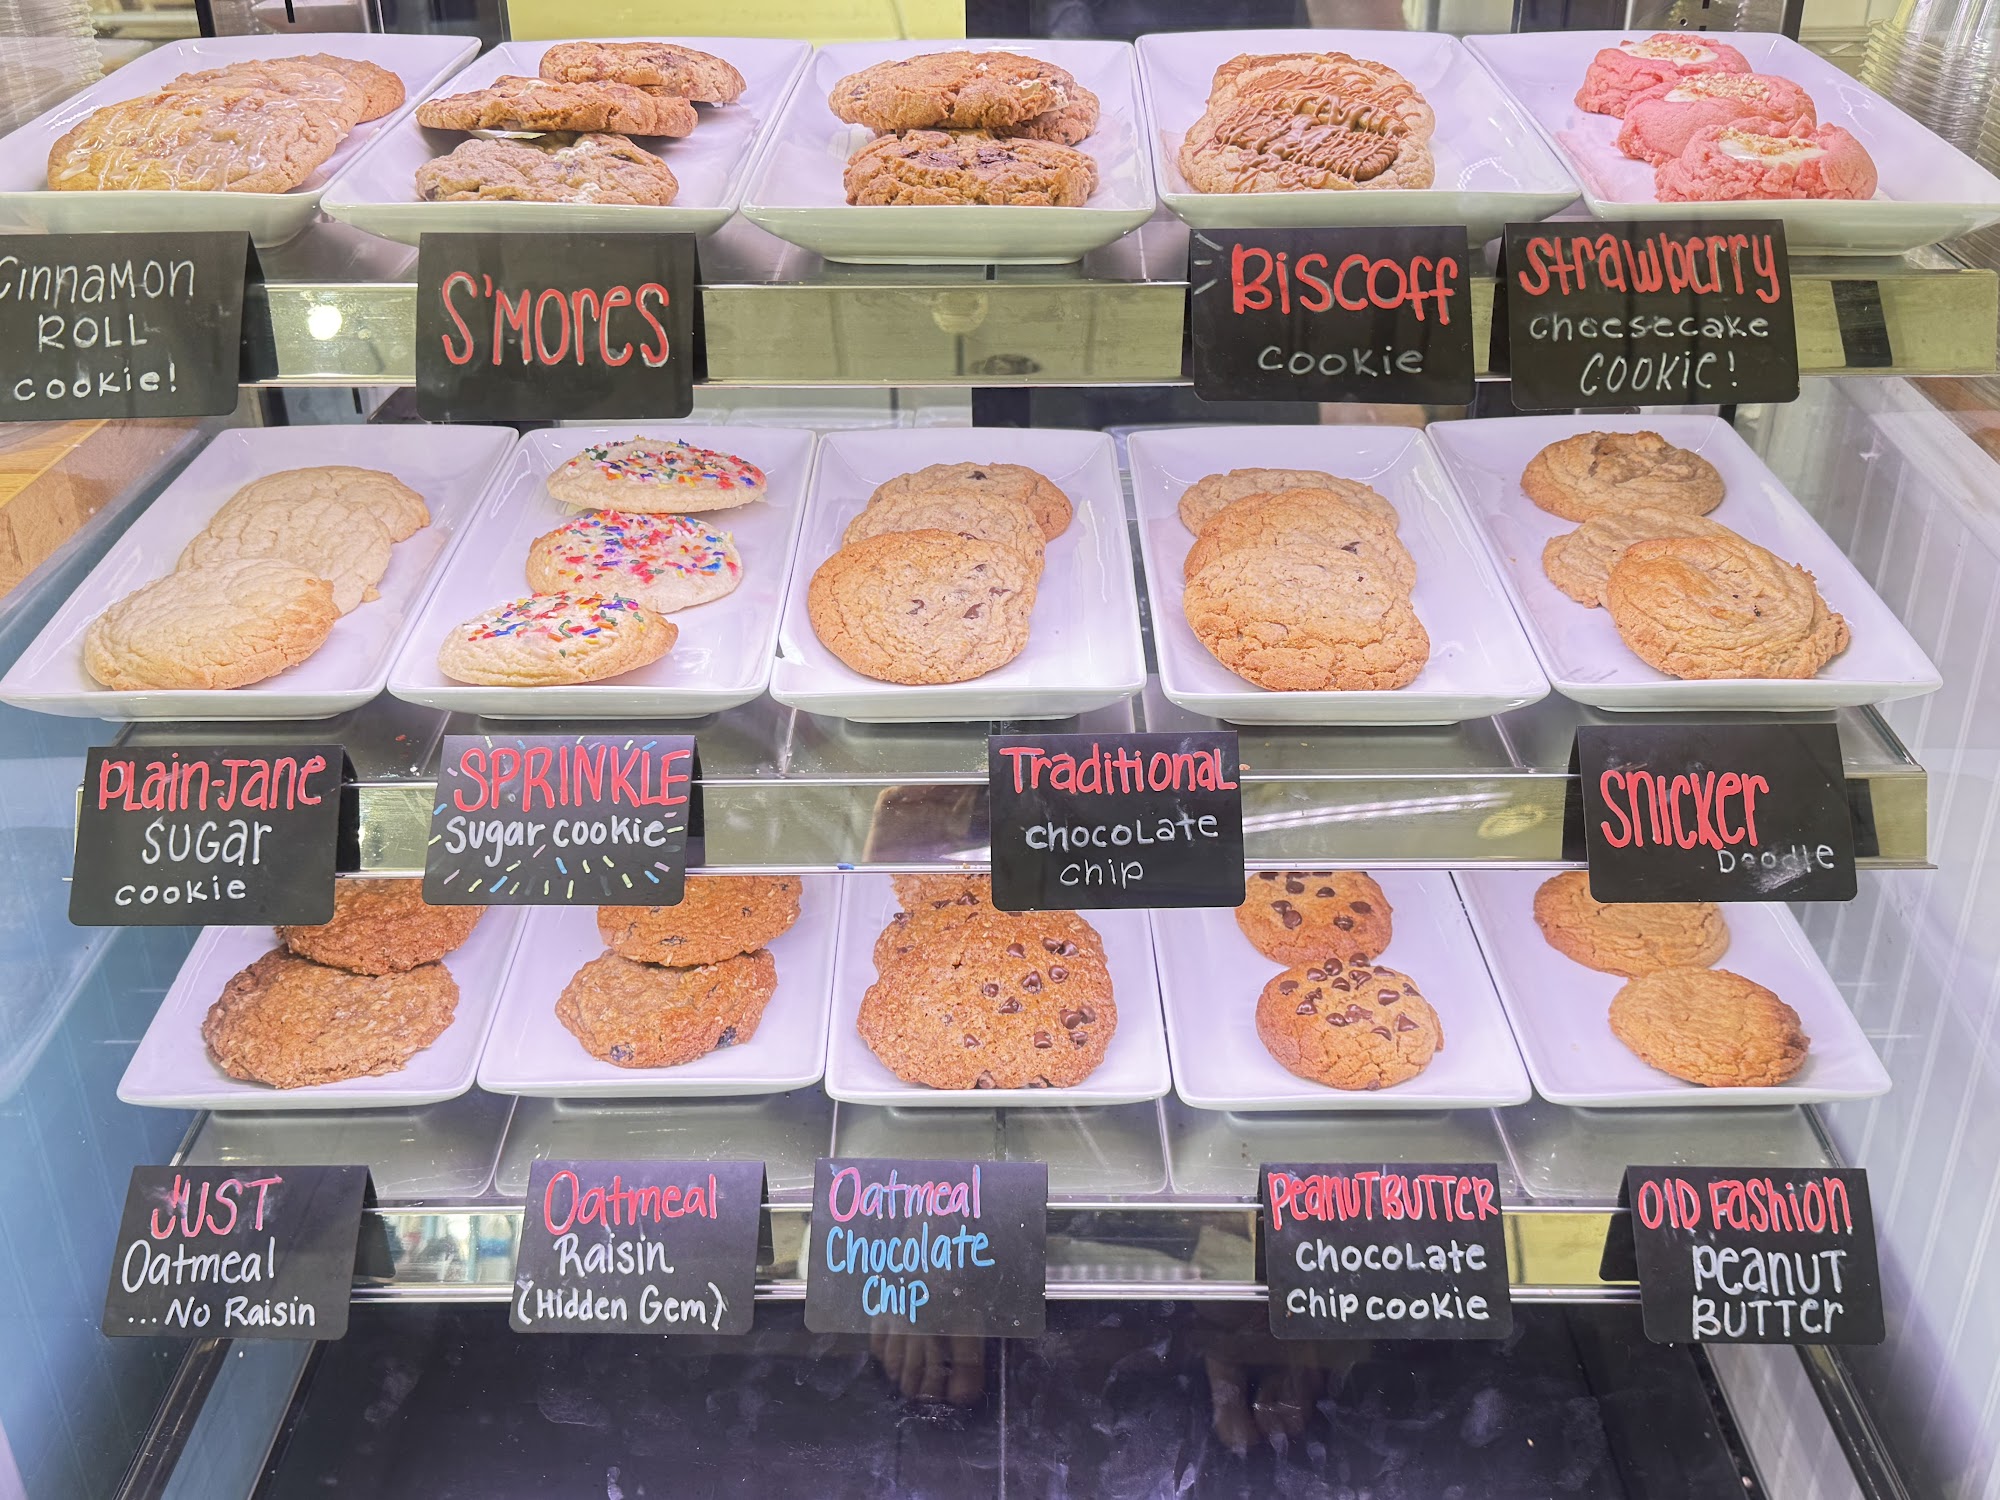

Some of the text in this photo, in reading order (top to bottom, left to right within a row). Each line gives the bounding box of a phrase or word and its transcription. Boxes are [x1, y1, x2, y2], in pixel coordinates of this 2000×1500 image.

[1519, 232, 1780, 304] Strawberry
[37, 314, 148, 350] ROLL
[454, 744, 690, 813] SPRINKLE
[445, 814, 545, 867] Sugar
[1060, 858, 1144, 889] chip
[150, 1174, 283, 1239] JUST
[544, 1167, 717, 1236] Oatmeal
[829, 1164, 981, 1222] Oatmeal
[121, 1236, 275, 1294] Oatmeal
[554, 1232, 673, 1276] Raisin
[826, 1222, 995, 1275] Chocolate
[225, 1295, 316, 1328] Raisin
[516, 1280, 729, 1331] (Hidden Gem)
[862, 1276, 929, 1324] Chip
[1287, 1288, 1358, 1324] chip
